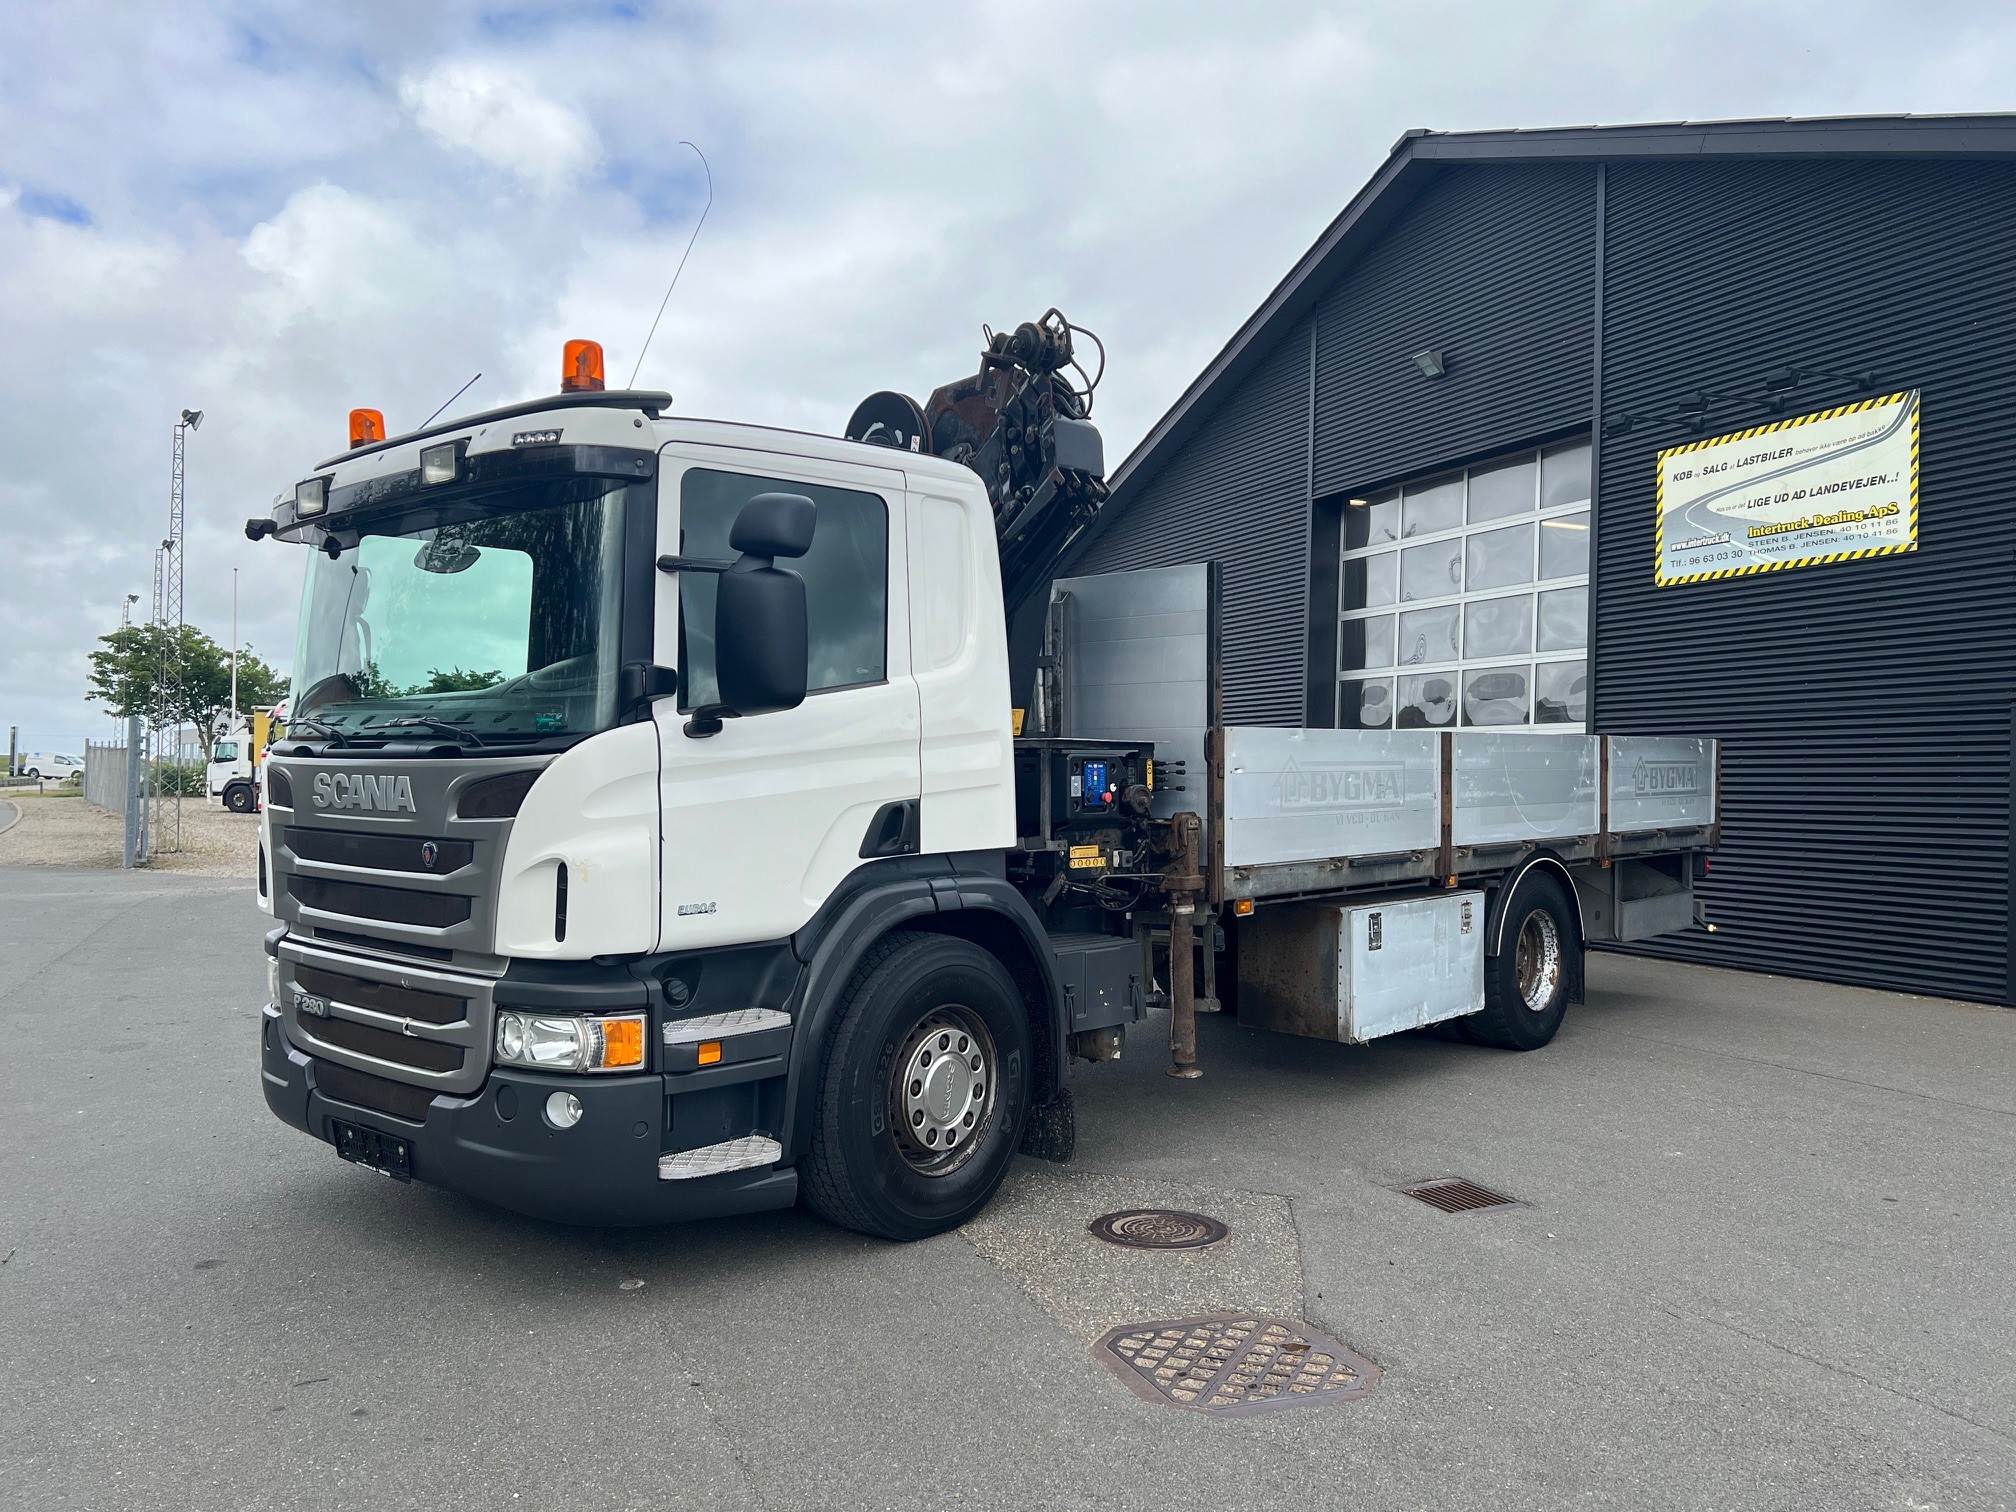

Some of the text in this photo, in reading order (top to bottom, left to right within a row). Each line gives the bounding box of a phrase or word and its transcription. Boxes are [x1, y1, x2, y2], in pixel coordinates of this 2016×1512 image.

[1672, 470, 1693, 482] KØB
[1702, 462, 1728, 476] SALG
[1736, 447, 1793, 468] LASTBILER
[1819, 441, 1831, 450] ikke
[1848, 435, 1857, 443] op
[1857, 432, 1866, 440] ad
[1747, 496, 1771, 509] LIGE
[1773, 493, 1789, 503] UD
[1791, 489, 1807, 501] AD
[1809, 471, 1900, 498] LANDEVEJEN..!
[1747, 501, 1900, 538] Intertruck Dealing ApS
[1670, 531, 1731, 552] www.intertruck.dk
[1748, 537, 1779, 548] STEEN
[1794, 529, 1837, 540] JENSEN:
[1748, 544, 1787, 556] THOMAS
[1800, 537, 1840, 548] JENSEN:
[1689, 557, 1701, 565] 96
[1702, 554, 1714, 563] 63
[1716, 552, 1728, 560] 03
[1731, 549, 1743, 558] 30
[1311, 770, 1400, 800] BYGMA
[1649, 767, 1695, 789] BYGMA
[312, 773, 416, 812] SCANIA
[294, 993, 324, 1016] P 280
